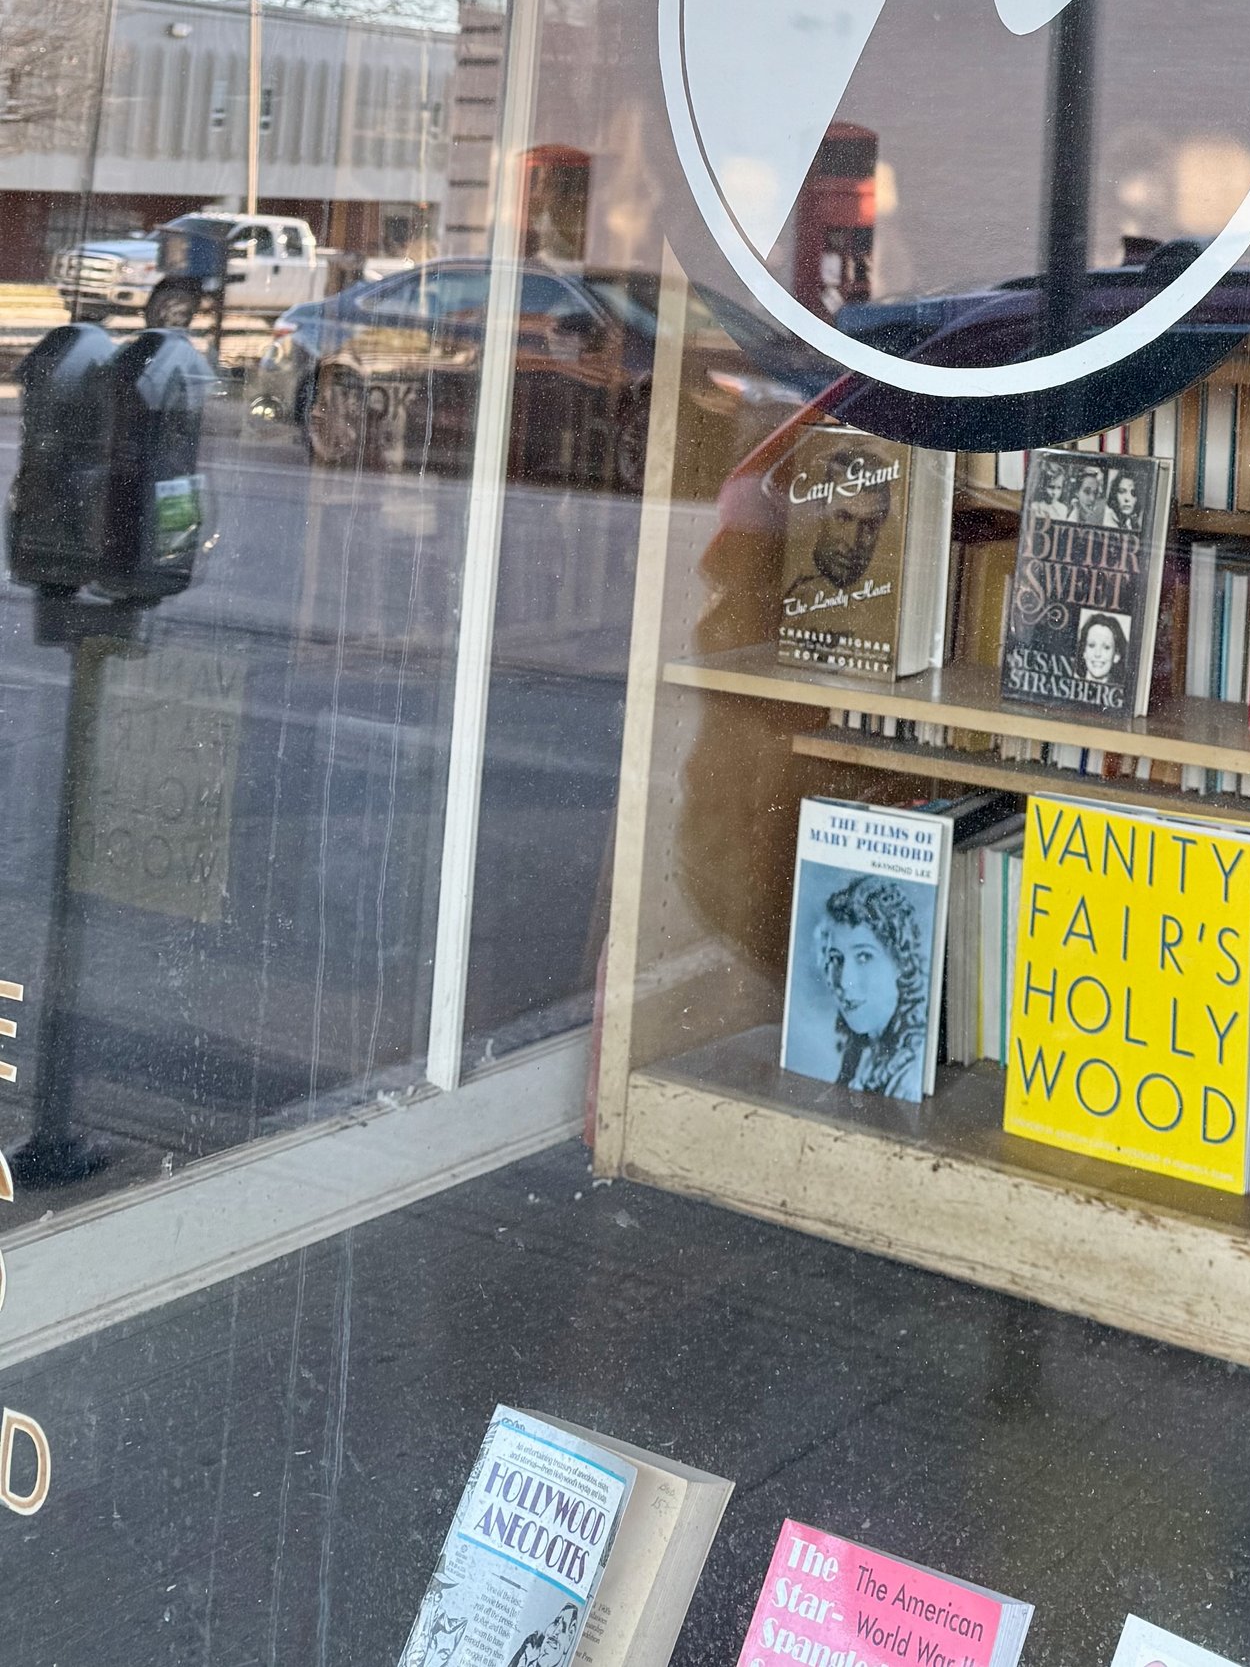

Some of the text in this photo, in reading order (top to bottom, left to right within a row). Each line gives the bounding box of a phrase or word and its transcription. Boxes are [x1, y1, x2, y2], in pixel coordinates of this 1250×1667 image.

[789, 458, 901, 505] Cary Grant
[1023, 512, 1140, 574] BITTER
[783, 579, 892, 617] The Lonely Heart
[1016, 559, 1129, 617] SWEET
[779, 626, 832, 644] CHARLES
[839, 636, 891, 653] HIGHAM
[794, 649, 819, 662] ROY
[827, 655, 890, 672] MOSELEY
[1011, 647, 1074, 677] SUSAN
[1008, 667, 1125, 709] STRASBERG
[810, 828, 934, 863] MARY PICKFORD
[830, 816, 933, 844] THE FILMS OF
[1034, 803, 1244, 904] VANITY
[871, 860, 931, 878] RAYMOND LEE
[1029, 882, 1242, 987] FAIR'S
[1023, 960, 1240, 1066] HOLLY
[1016, 1037, 1237, 1146] WOOD
[484, 1461, 606, 1547] HOLLYWOOD
[474, 1503, 590, 1585] ANECDOTES
[787, 1536, 839, 1582] The
[770, 1577, 844, 1625] Star-
[855, 1565, 984, 1643] The American
[856, 1610, 955, 1667] World War
